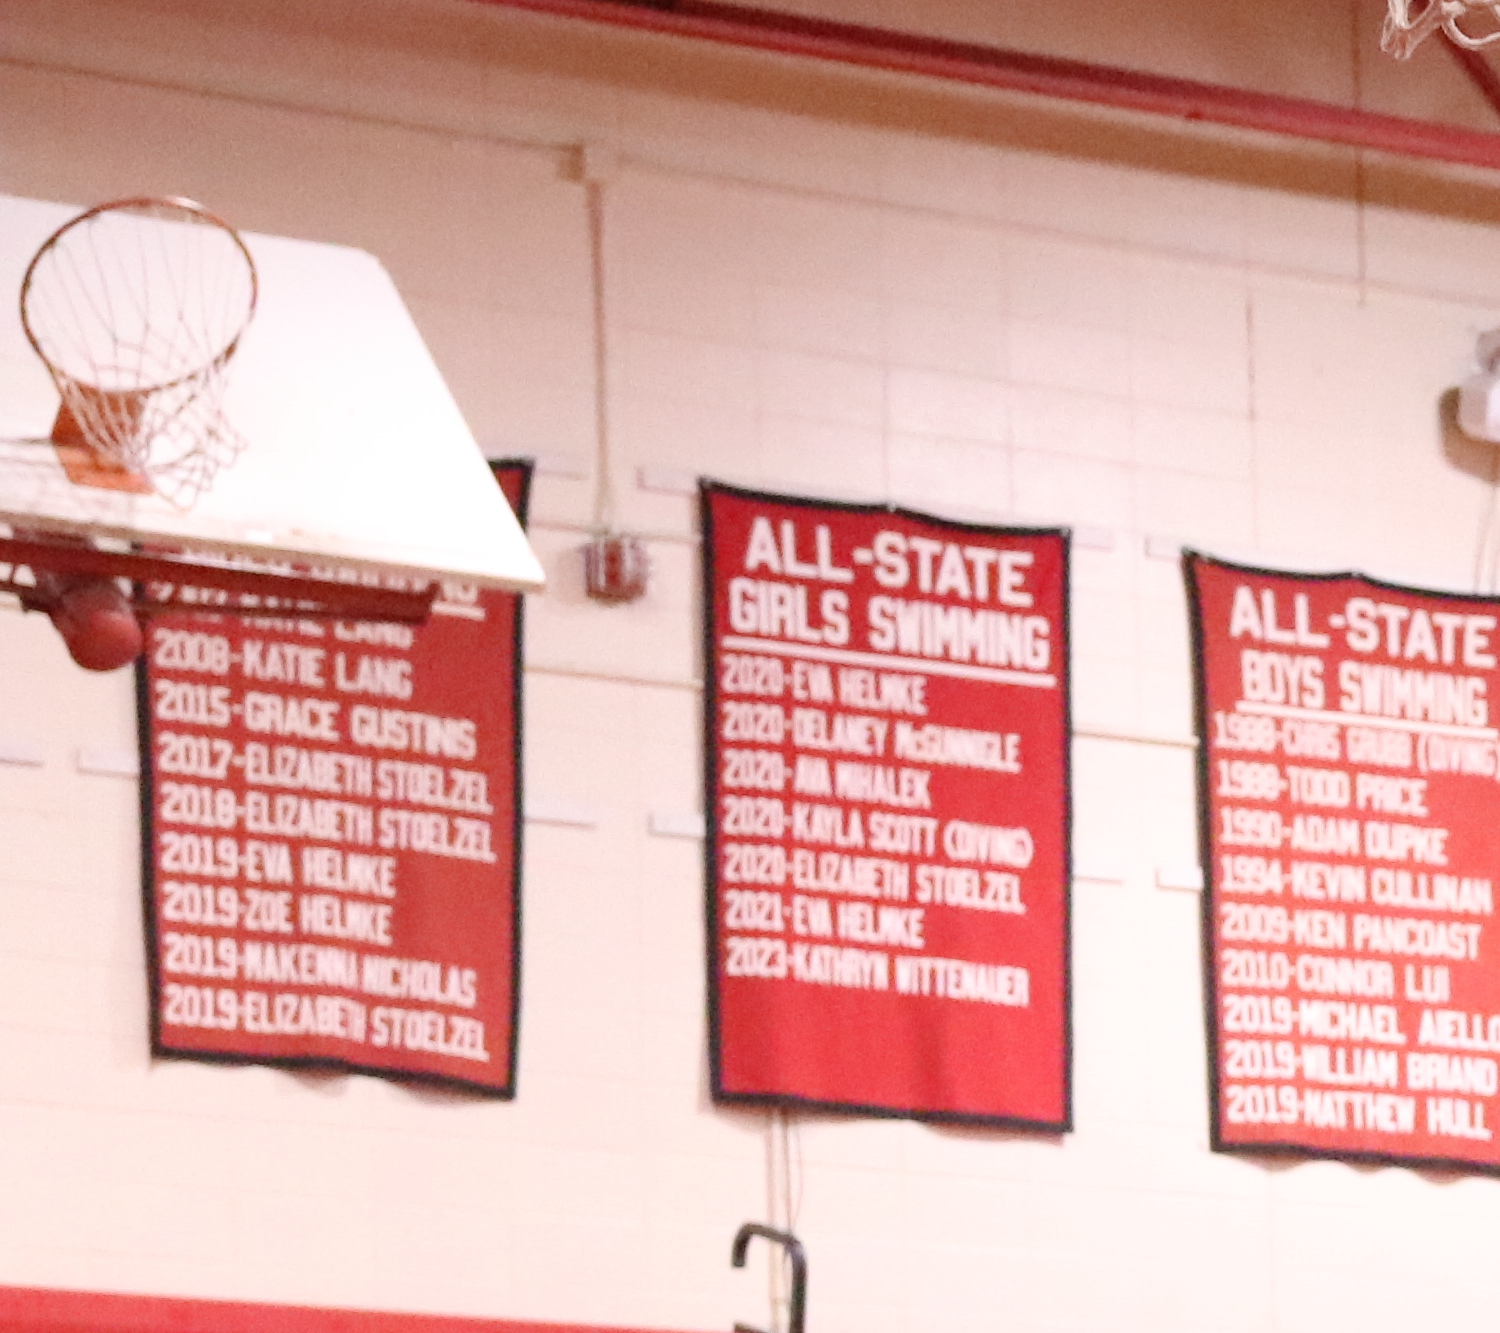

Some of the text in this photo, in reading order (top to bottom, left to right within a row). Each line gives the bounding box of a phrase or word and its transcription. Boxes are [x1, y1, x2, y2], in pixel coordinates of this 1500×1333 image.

[745, 516, 1034, 608] ALL-STATE
[728, 576, 1050, 671] GIRLS SWIMMING
[1229, 585, 1498, 670] ALL-STATE
[335, 651, 414, 699] LANG
[838, 666, 929, 717] HELMKE
[1240, 649, 1489, 727] BOYS SWIMMING
[154, 678, 340, 742] 2015-GRACE
[156, 731, 494, 815] 2017-ELIZABETH STOELZEL
[1355, 772, 1429, 818] PRICE
[160, 781, 497, 864] 2018-ELIZABETH STOELZEL
[1219, 805, 1360, 855] 1990-ADAM
[160, 830, 397, 899] 2019-EVA HELMKE
[914, 863, 1027, 915] STOELZEL
[1220, 854, 1367, 902] 1994-KEVIN
[162, 880, 394, 946] 2019-ZOE HELMKE
[837, 901, 926, 950] HELMKE
[1353, 913, 1482, 961] PANCOAST
[362, 953, 478, 1009] NICHOLAS
[1221, 948, 1395, 1000] 2010-CONNOR
[371, 1006, 490, 1062] STOELZEL
[1222, 994, 1408, 1045] 2019-MICHAEL
[1224, 1039, 1399, 1089] 2019-WILLIAM
[1225, 1085, 1493, 1142] 2019-MATTHEW HULL
